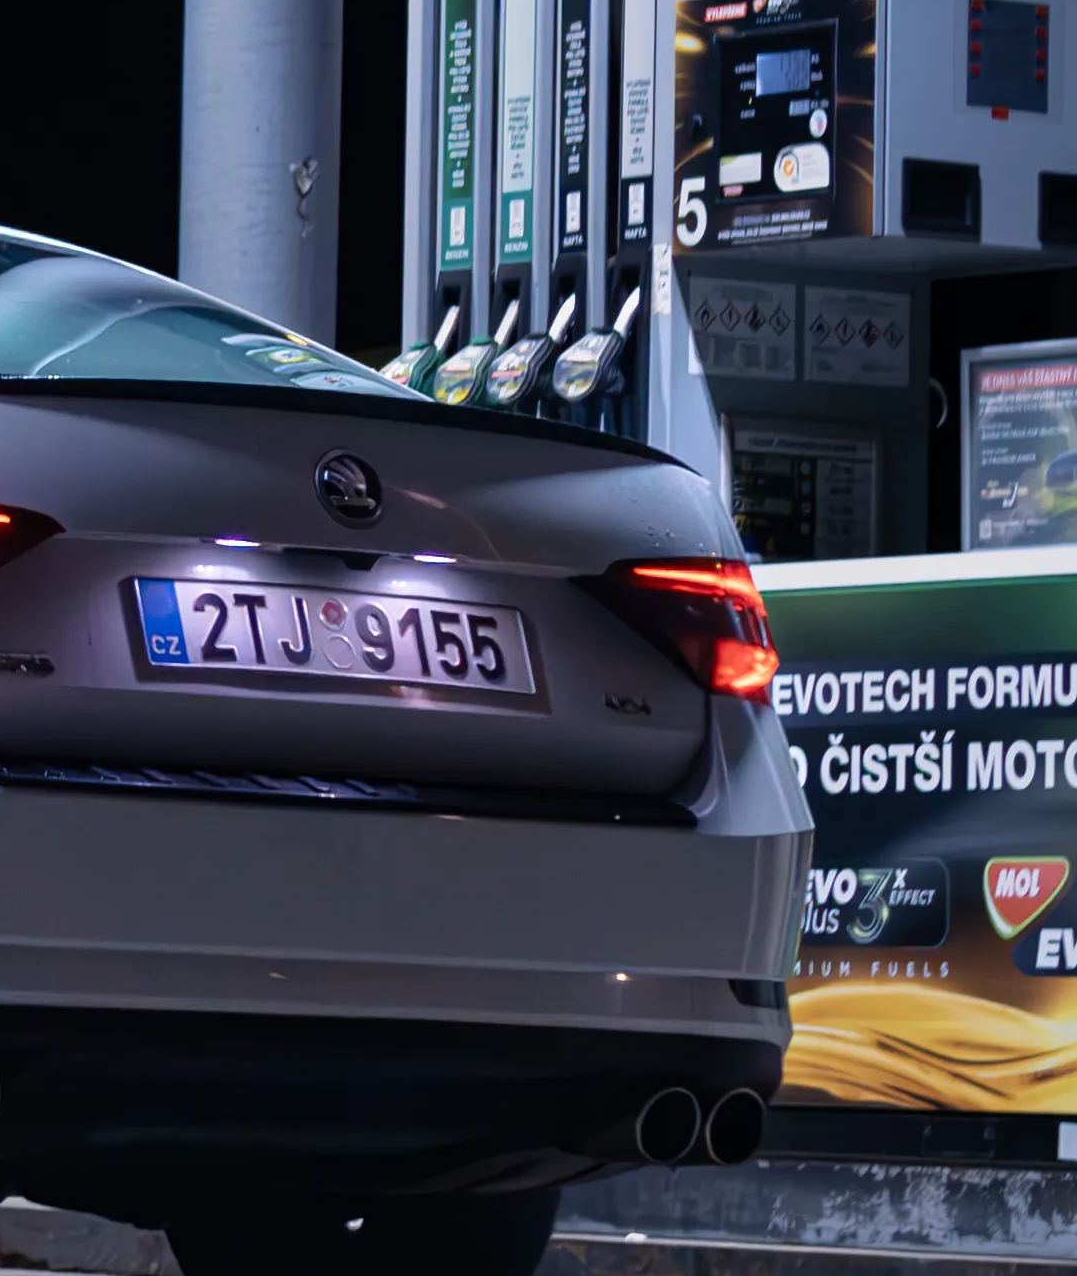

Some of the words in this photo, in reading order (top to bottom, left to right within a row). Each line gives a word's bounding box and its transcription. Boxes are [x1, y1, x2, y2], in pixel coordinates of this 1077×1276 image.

[676, 176, 707, 247] 5
[151, 634, 182, 656] CZ
[193, 592, 313, 666] 2TJ
[356, 601, 507, 682] 9155
[772, 668, 935, 716] EVOTECH
[946, 663, 1077, 711] FORMU
[820, 729, 956, 794] ČISTŠÍ
[889, 889, 936, 907] EFFECT
[994, 867, 1041, 898] MOL
[801, 901, 841, 935] lus
[846, 867, 894, 944] 3
[870, 959, 950, 978] FUELS
